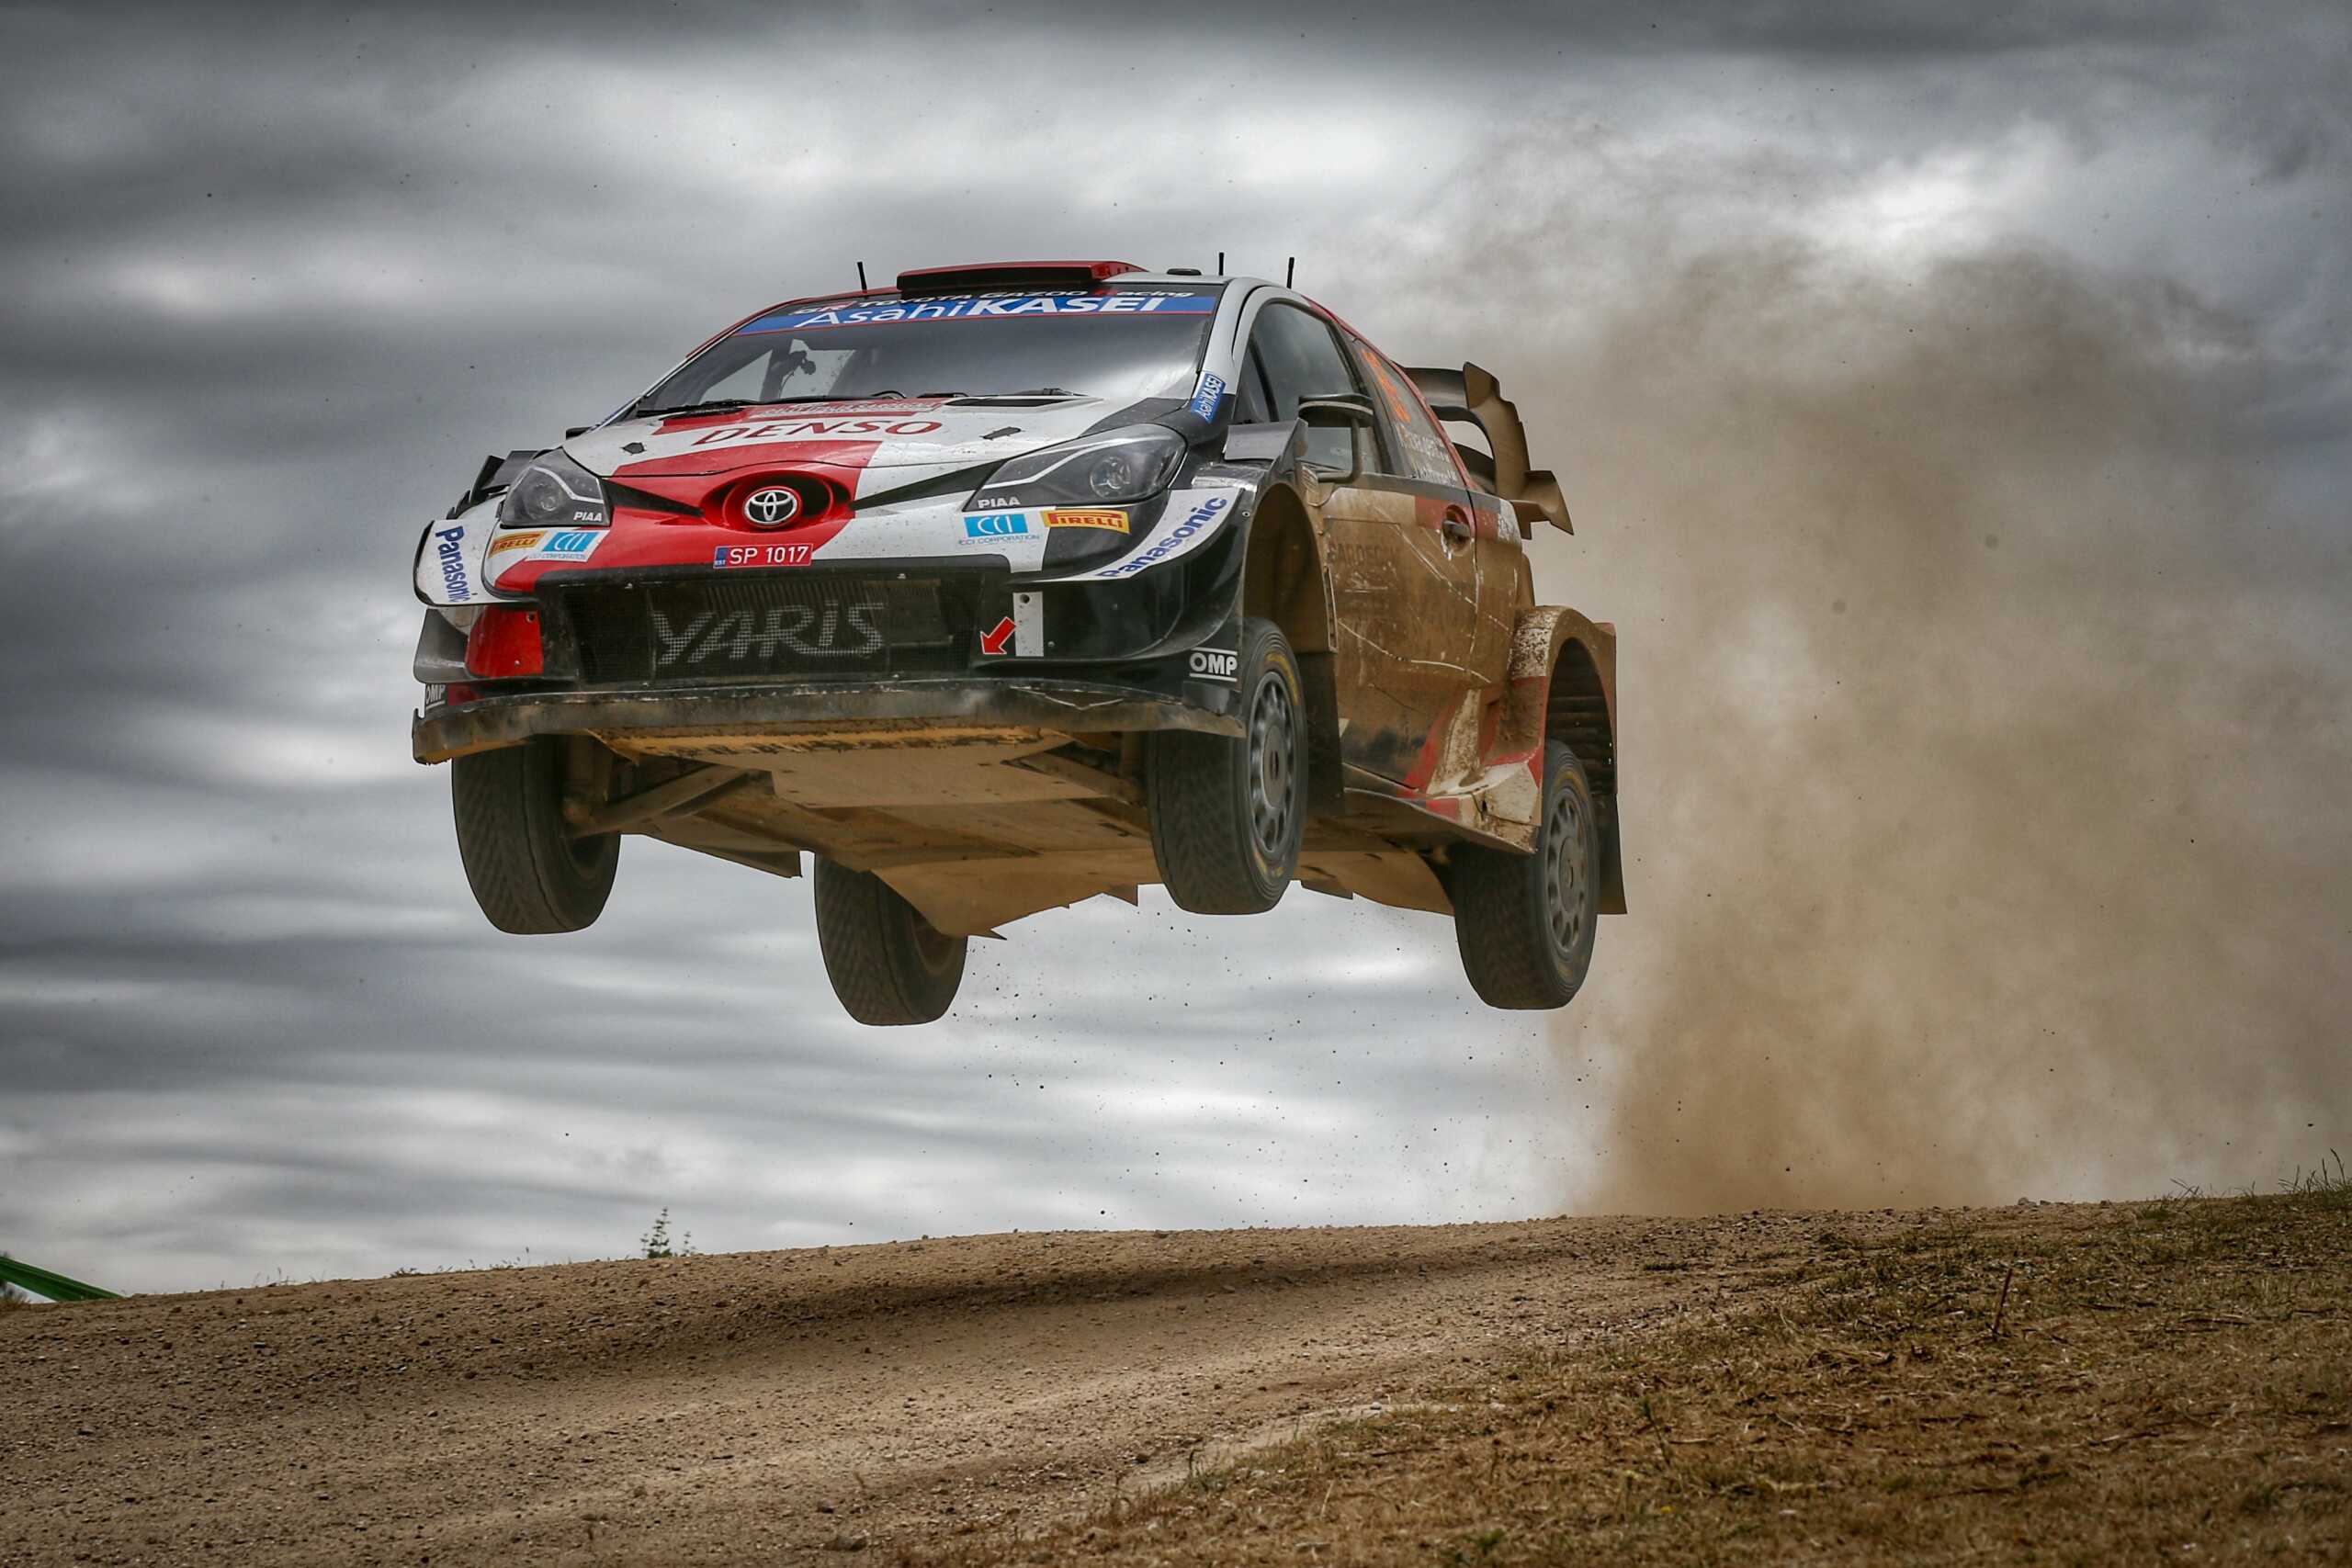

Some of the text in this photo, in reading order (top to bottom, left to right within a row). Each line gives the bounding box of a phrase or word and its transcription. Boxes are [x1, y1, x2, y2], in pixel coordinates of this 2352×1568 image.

[858, 294, 972, 307] TOYOTA
[979, 290, 1088, 299] GAZOO
[794, 296, 1166, 328] AsahiKASEI
[691, 420, 944, 446] DENSO
[978, 497, 1022, 509] PIAA
[573, 512, 603, 522] PIAA
[1047, 511, 1123, 528] PIRELLI
[1095, 497, 1227, 577] Panasonic
[435, 525, 470, 603] Panasonic
[729, 546, 809, 565] SP 1017
[650, 599, 888, 666] YARIS
[1189, 652, 1238, 676] OMP
[425, 683, 447, 705] OMP
